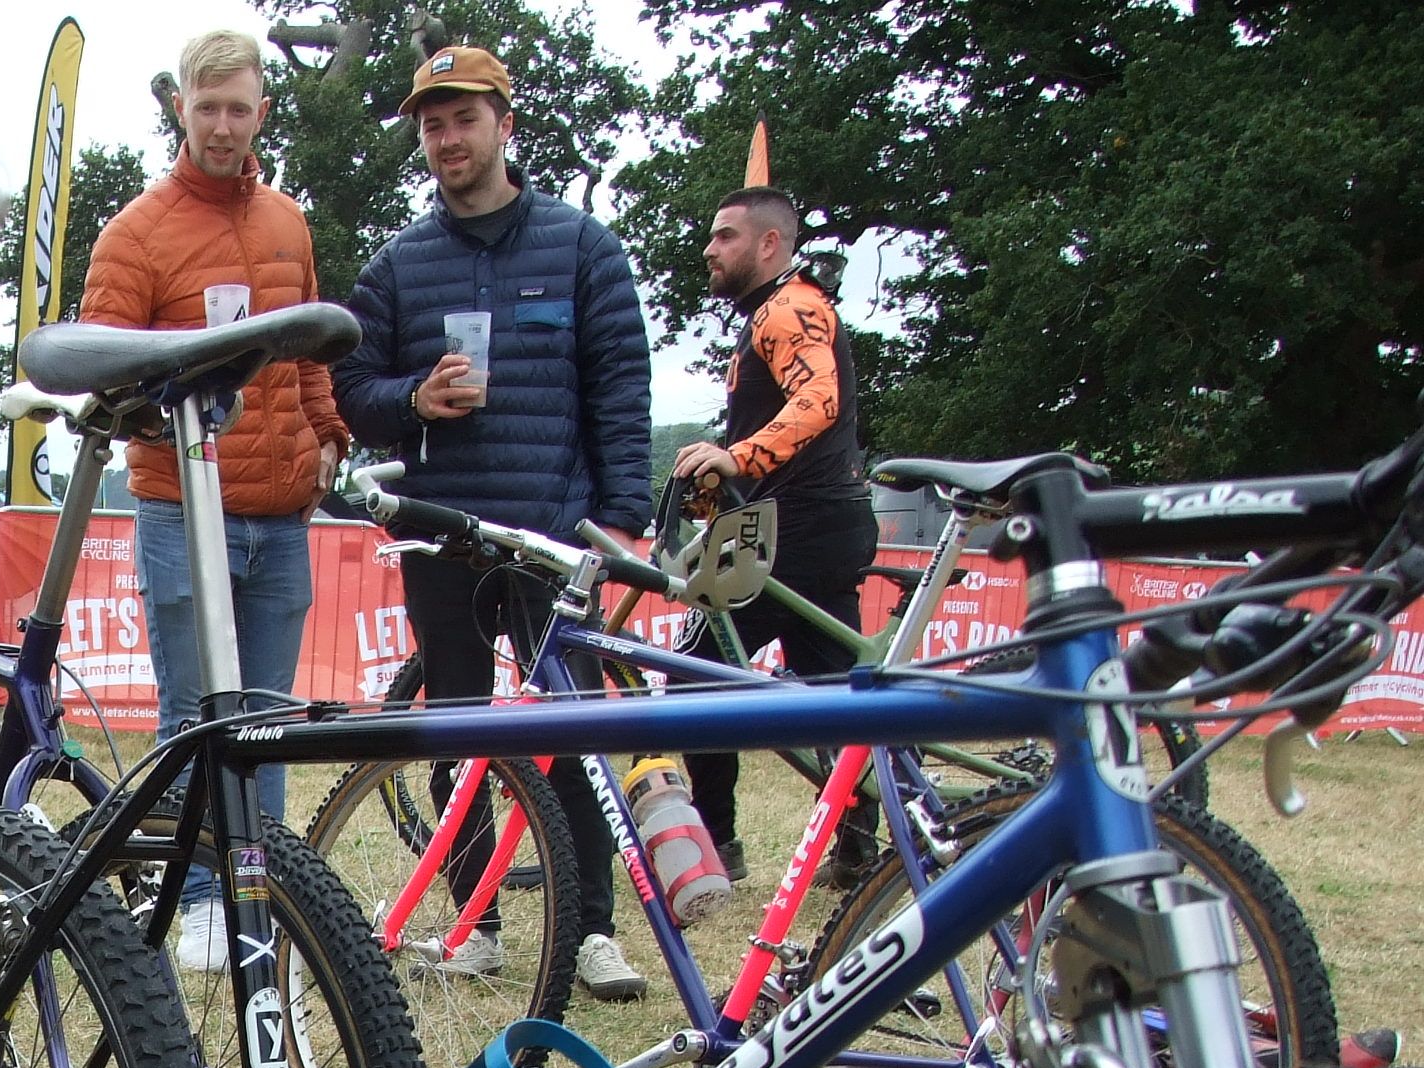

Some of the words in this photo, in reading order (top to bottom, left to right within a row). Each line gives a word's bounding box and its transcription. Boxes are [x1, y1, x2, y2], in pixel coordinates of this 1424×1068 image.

[740, 511, 760, 552] FOX
[82, 538, 130, 550] BRITISH
[81, 550, 130, 561] CYCLING
[942, 600, 980, 615] PRESENTS
[236, 725, 284, 742] Diabolo
[746, 930, 908, 1068] Yates
